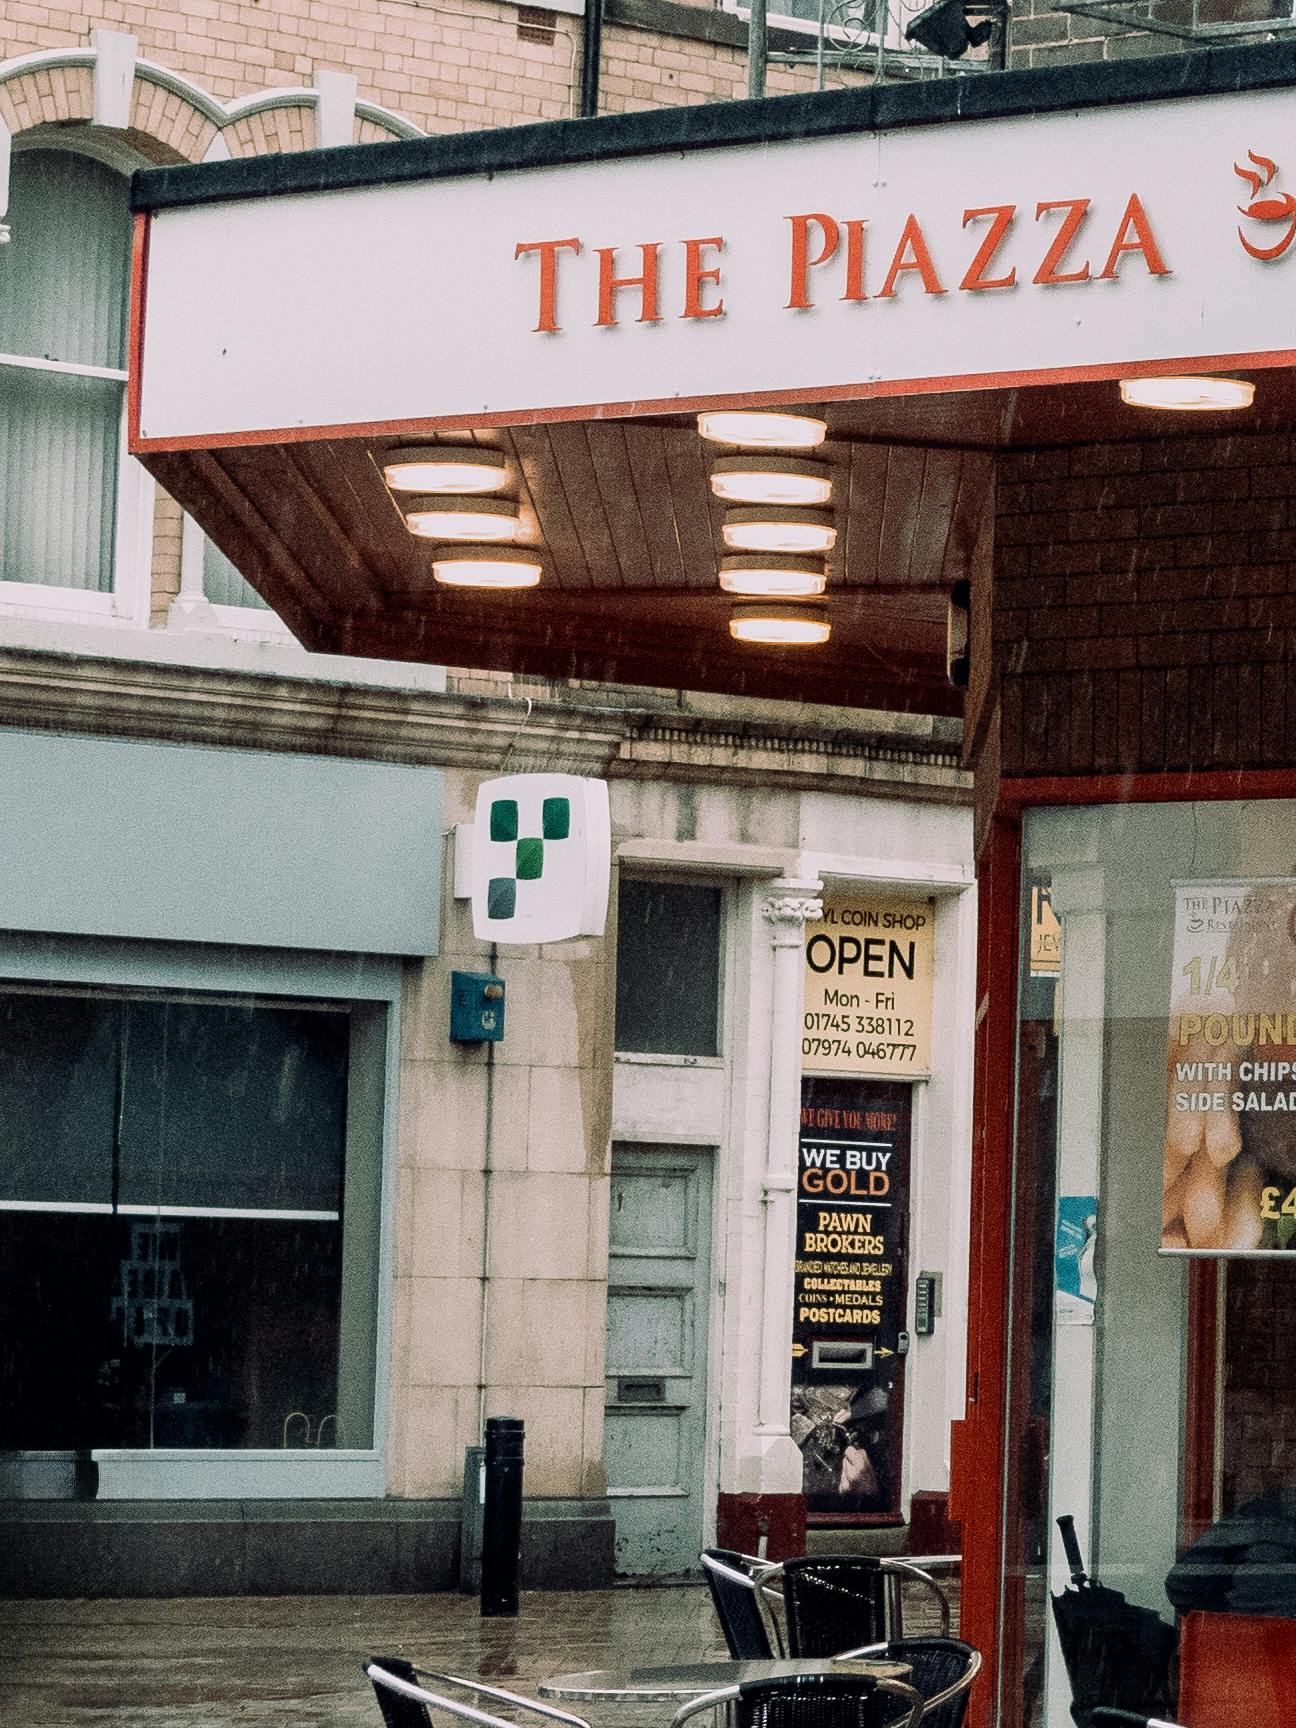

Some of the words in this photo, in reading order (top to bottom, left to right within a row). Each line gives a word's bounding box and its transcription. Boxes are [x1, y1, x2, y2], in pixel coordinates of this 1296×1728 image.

[514, 235, 725, 332] THE
[783, 192, 1175, 309] PIAZZA
[841, 909, 880, 927] COIN
[883, 913, 926, 932] SHOP
[806, 933, 916, 981] OPEN
[1183, 955, 1241, 996] 1/4
[824, 988, 860, 1008] Mon
[875, 992, 895, 1010] Fri
[804, 1012, 851, 1033] 01745
[855, 1015, 915, 1037] 338112
[802, 1038, 852, 1057] 07974
[856, 1041, 917, 1062] 046777
[1176, 1062, 1232, 1082] WITH
[1175, 1092, 1226, 1112] SIDE
[802, 1147, 841, 1168] WE
[846, 1150, 892, 1171] BUY
[802, 1168, 890, 1196] GOLD
[818, 1211, 873, 1234] PAWN
[804, 1233, 885, 1256] BROKERS
[803, 1277, 881, 1292] COLLECTABLES
[835, 1293, 883, 1306] MEDALS
[800, 1307, 881, 1324] POSTCARDS
